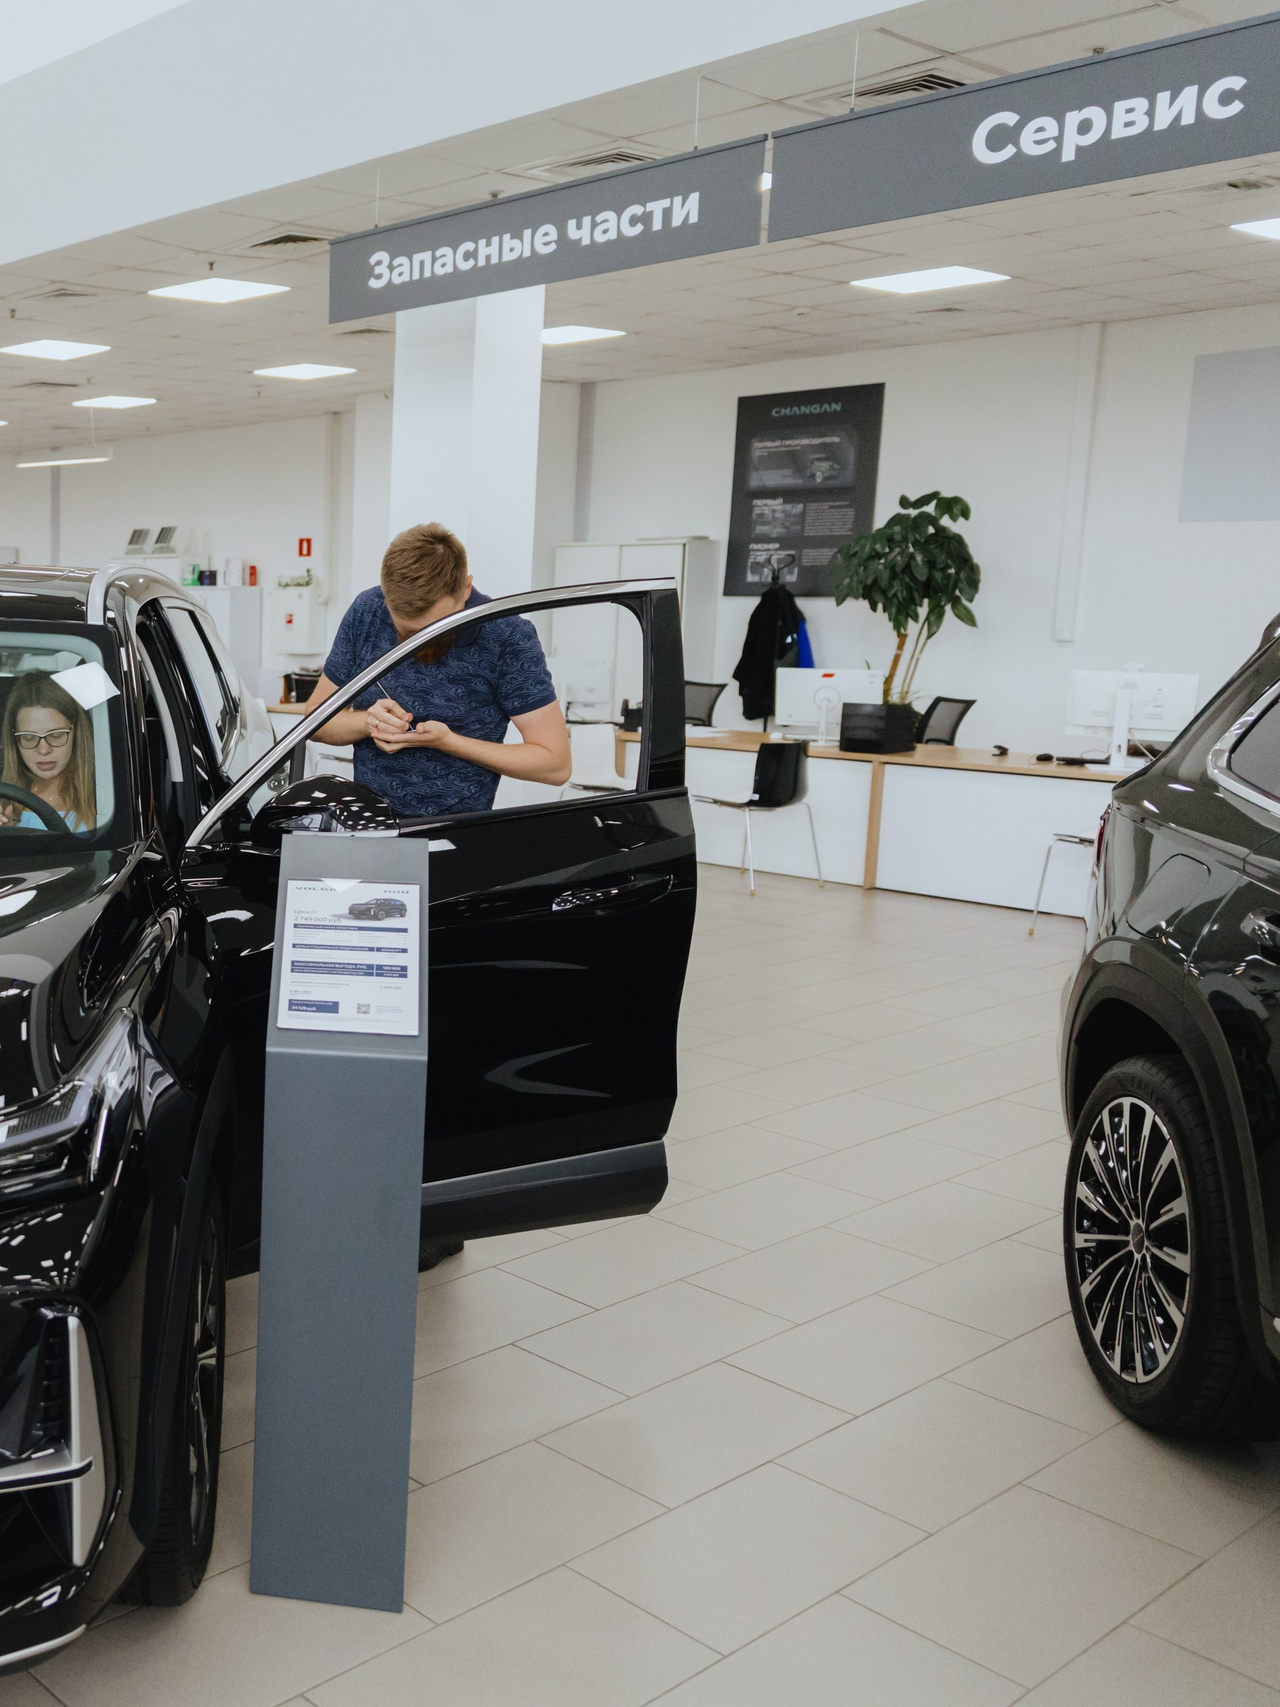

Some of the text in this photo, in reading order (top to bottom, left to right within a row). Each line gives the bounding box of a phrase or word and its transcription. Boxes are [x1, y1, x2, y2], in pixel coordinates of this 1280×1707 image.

[972, 76, 1248, 165] Сервис
[368, 192, 700, 289] Запасные части
[771, 402, 842, 417] CHANGAN
